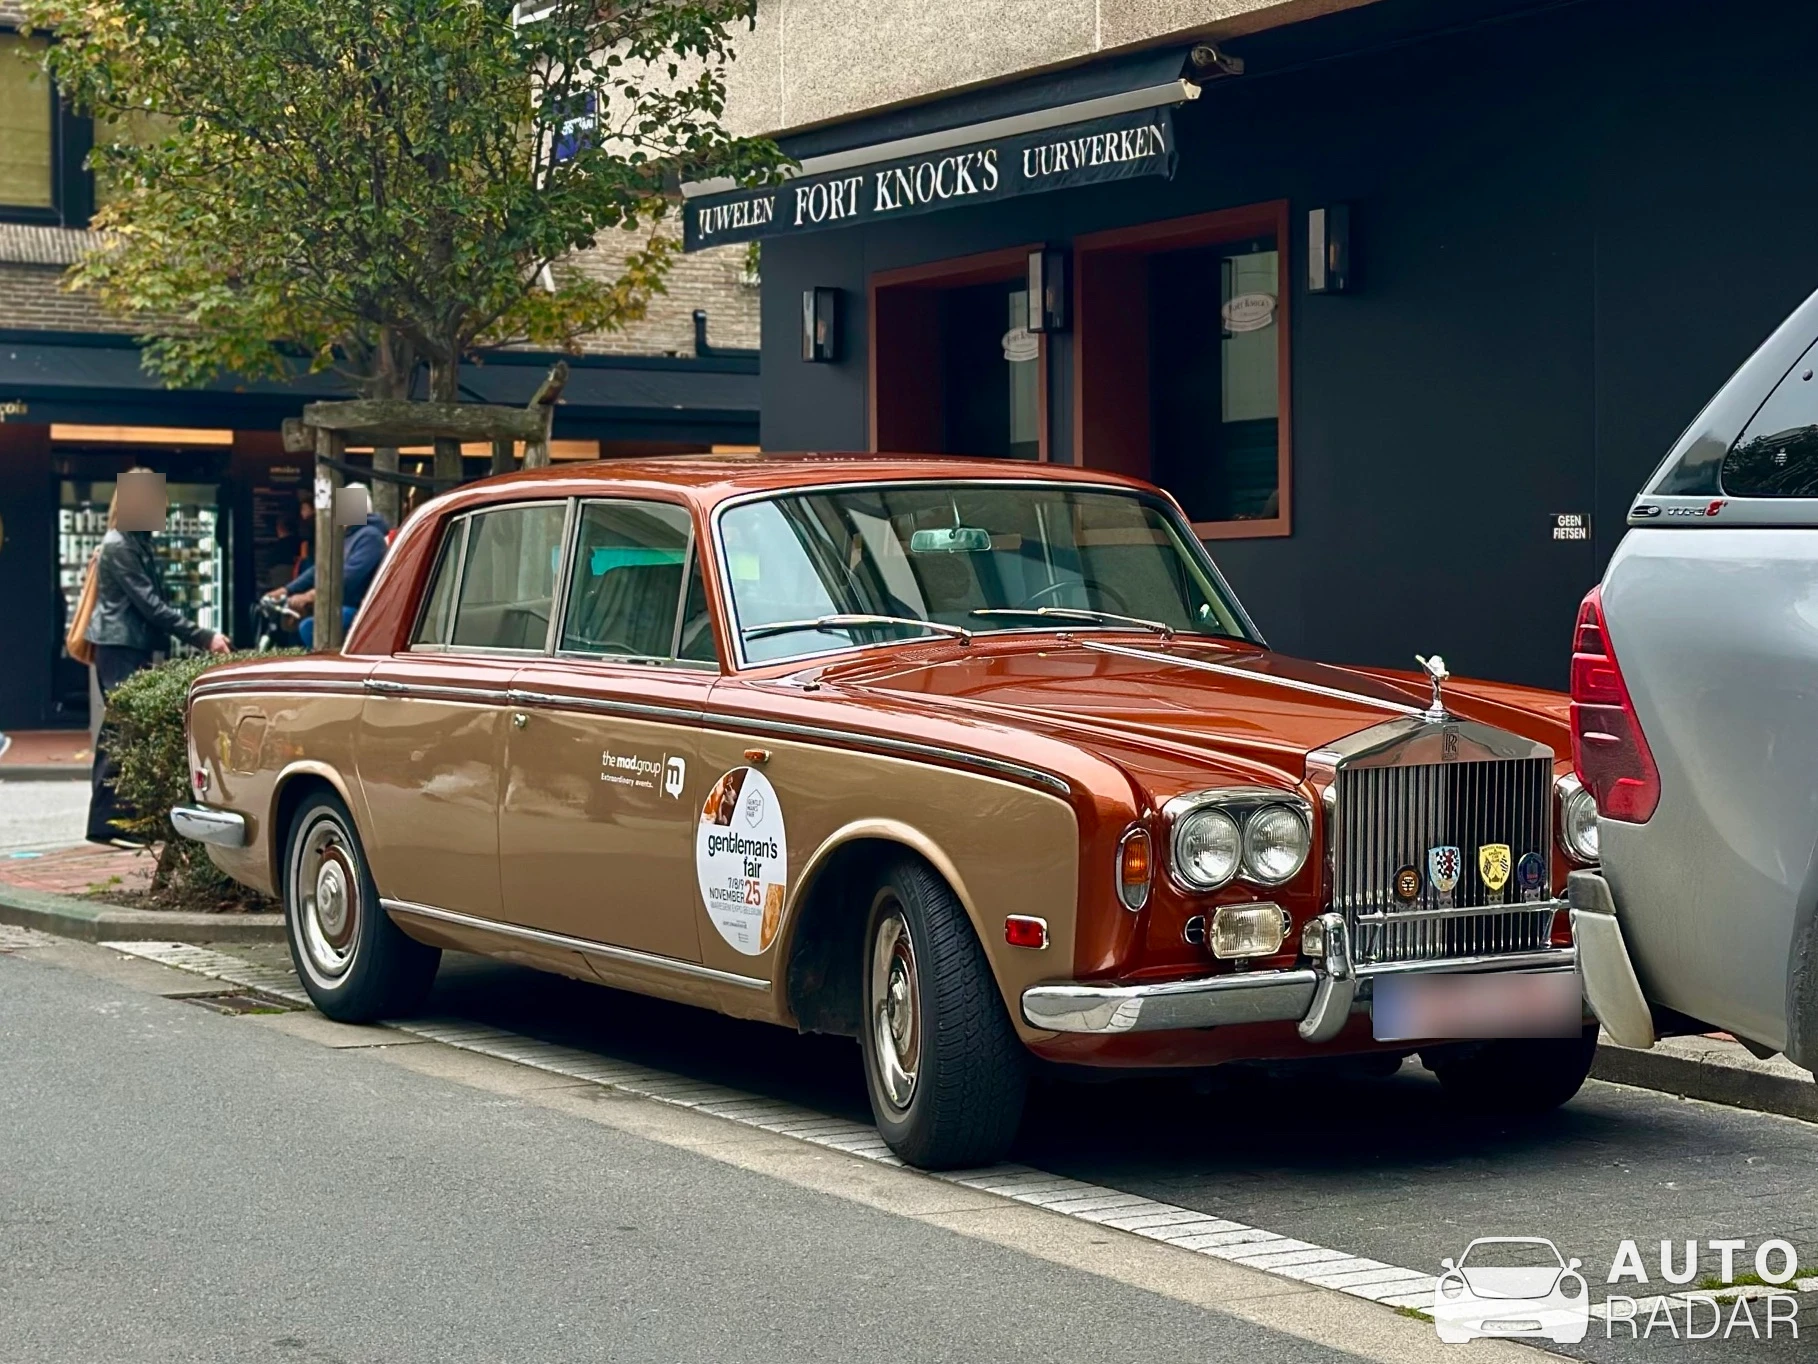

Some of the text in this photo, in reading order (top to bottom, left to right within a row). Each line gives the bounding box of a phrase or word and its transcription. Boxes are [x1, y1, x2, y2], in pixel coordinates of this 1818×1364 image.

[699, 123, 1166, 239] JUWELEN FORT KNOCK'S UURWERKEN
[1557, 515, 1582, 527] GEEN
[1553, 527, 1586, 540] FIETSEN
[602, 750, 616, 767] the
[708, 831, 778, 860] gentleman's
[743, 855, 762, 879] fair
[709, 879, 761, 906] NOVEMBER 25
[728, 877, 744, 891] 7/8/9
